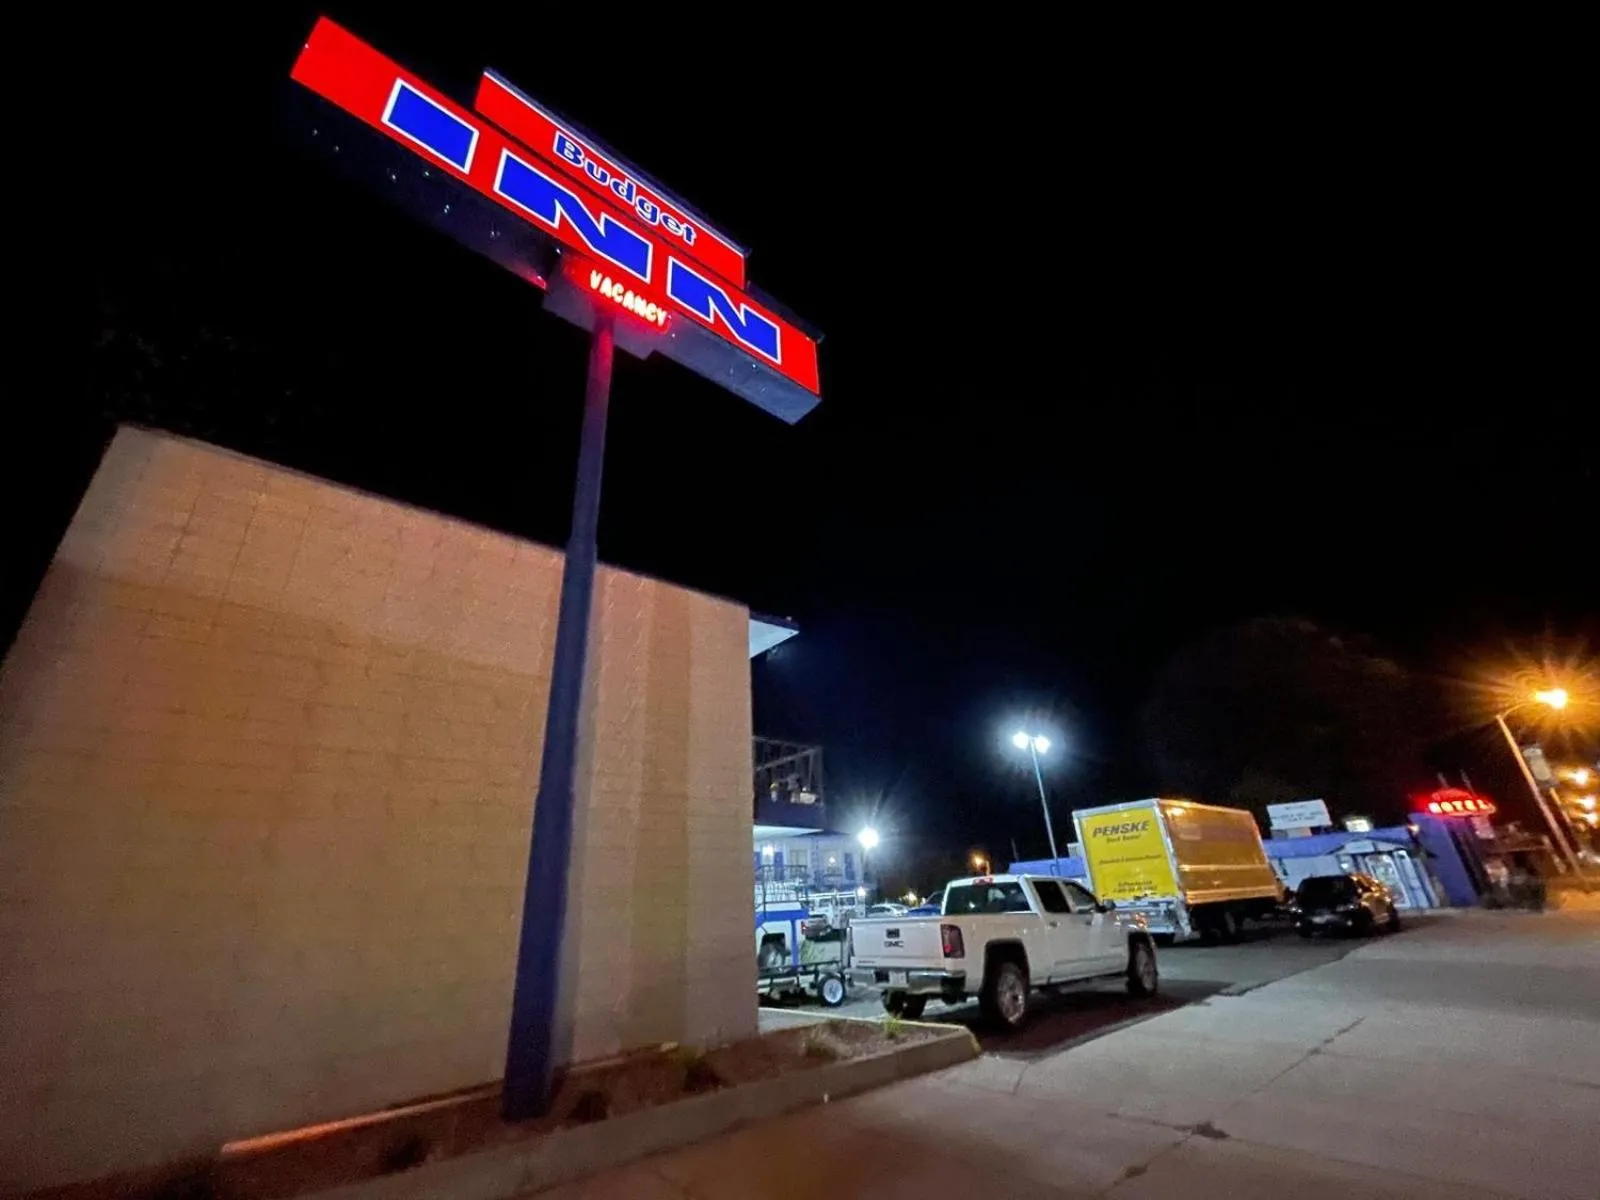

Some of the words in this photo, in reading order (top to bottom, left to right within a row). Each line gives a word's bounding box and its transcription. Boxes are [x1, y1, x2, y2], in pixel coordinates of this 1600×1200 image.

[553, 130, 697, 247] Budget
[380, 78, 782, 365] INN
[589, 268, 669, 327] VACANCY
[1092, 820, 1152, 839] PENSKE
[884, 940, 905, 949] GMC
